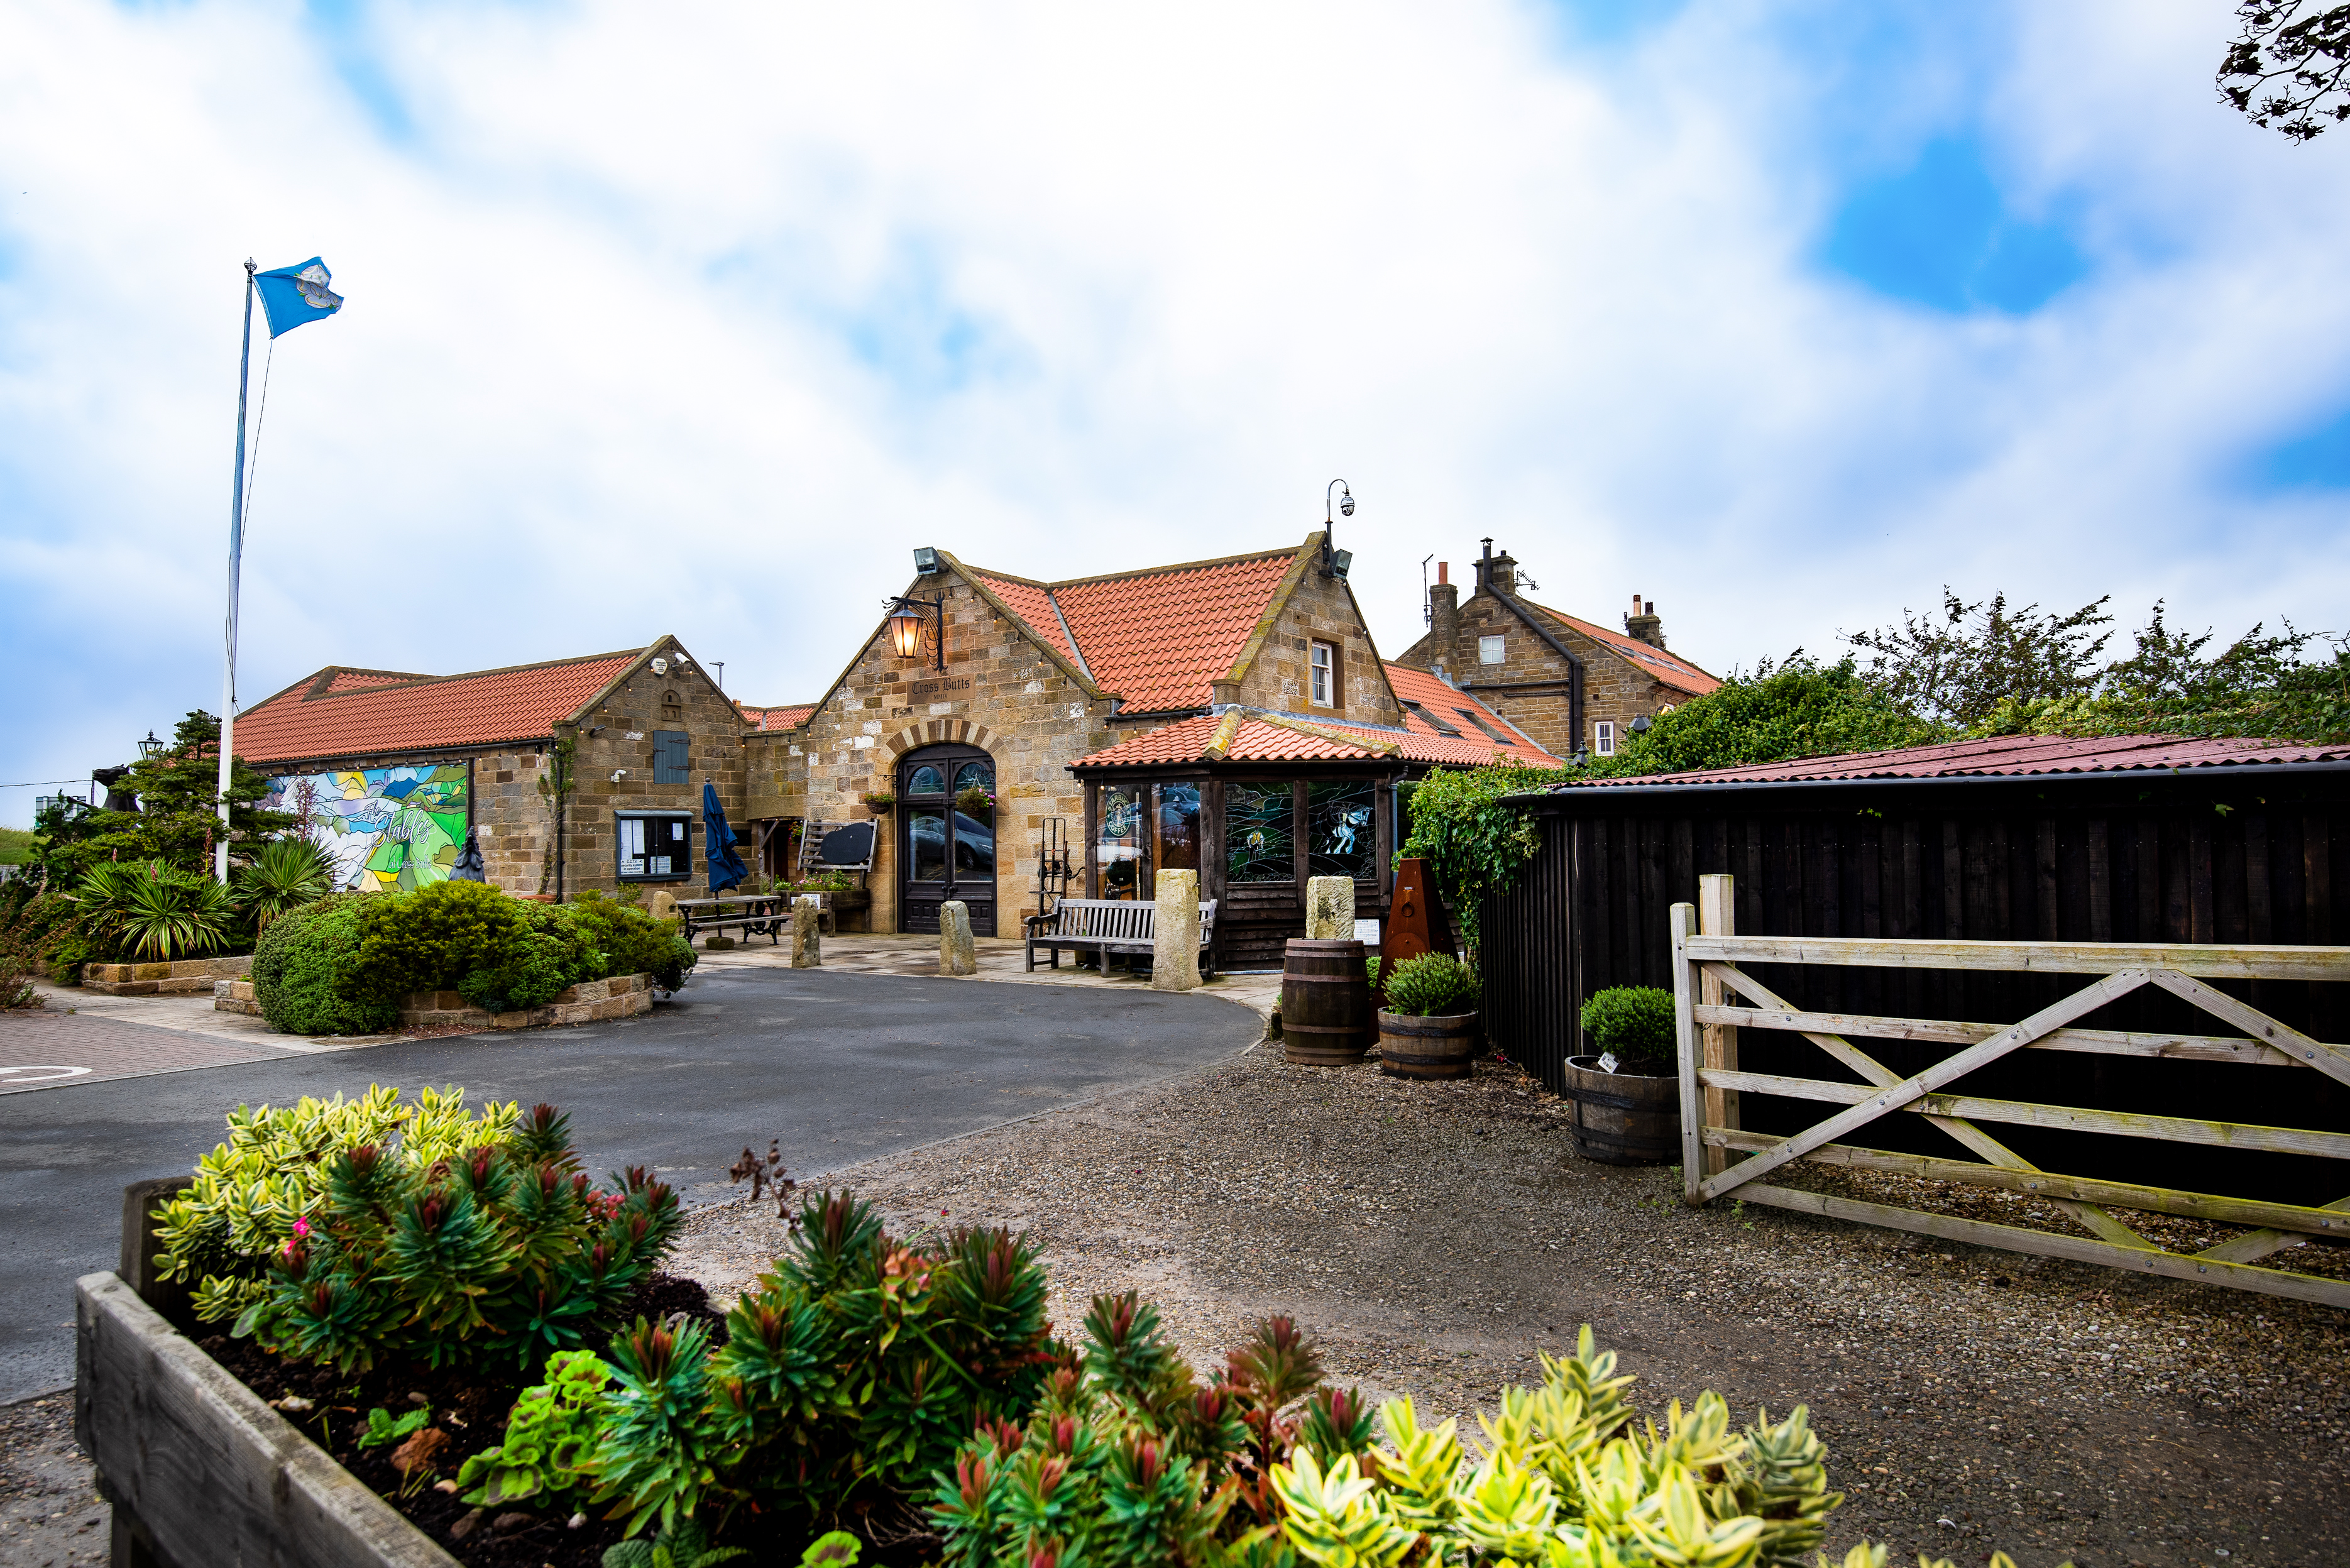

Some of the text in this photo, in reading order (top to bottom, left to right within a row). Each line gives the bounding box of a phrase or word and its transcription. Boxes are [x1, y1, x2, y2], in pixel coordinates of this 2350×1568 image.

[912, 677, 970, 694] Cross Butts
[365, 799, 382, 820] The
[1108, 794, 1131, 815] STARBUCKS
[371, 809, 434, 848] Stables
[1109, 821, 1127, 834] COFFEE
[397, 856, 415, 869] Cross
[415, 854, 432, 869] Butts
